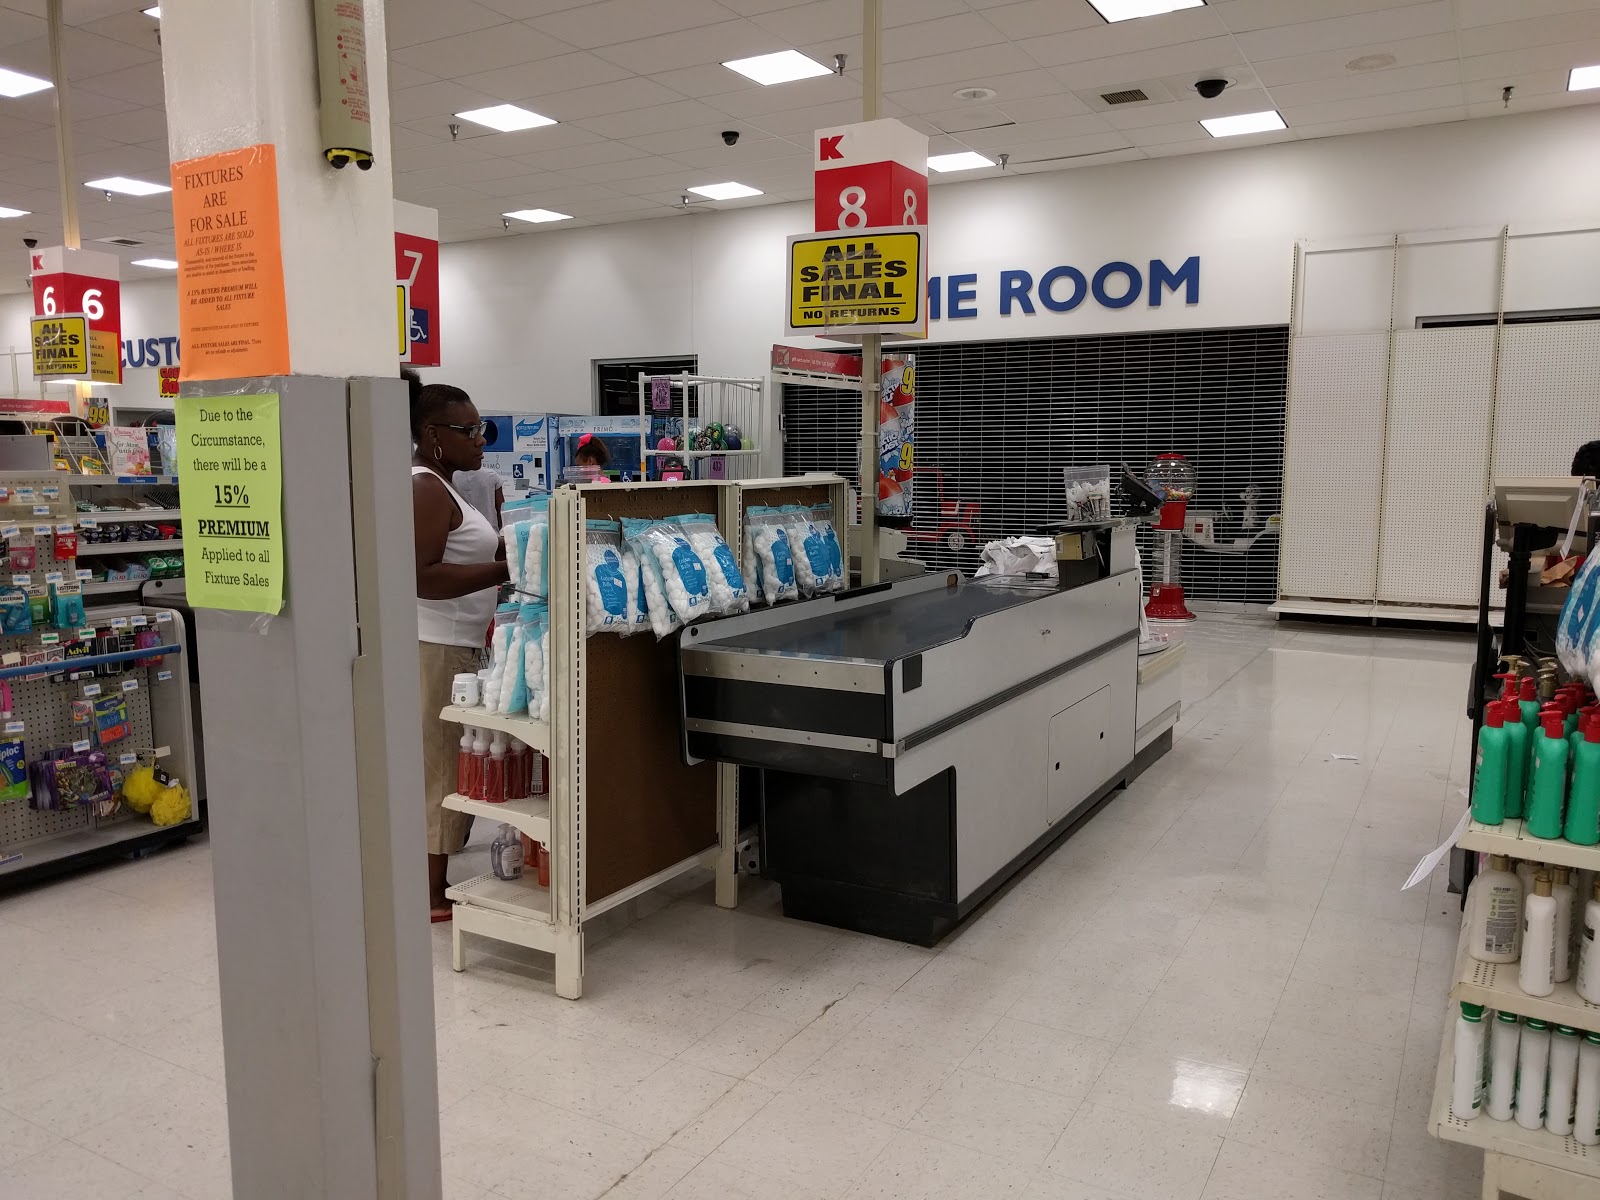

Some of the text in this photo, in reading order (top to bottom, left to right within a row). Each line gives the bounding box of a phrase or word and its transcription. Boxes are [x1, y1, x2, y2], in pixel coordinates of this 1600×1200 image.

[819, 135, 844, 161] K
[184, 166, 243, 190] FIXTURES
[203, 191, 227, 208] ARE
[838, 186, 867, 230] 8
[903, 188, 918, 226] 8
[190, 210, 248, 233] FOR SALE
[184, 230, 254, 247] ALL FIXTURES ARE SOLD
[196, 247, 210, 256] AS-IS
[214, 244, 235, 253] WHERE
[822, 243, 881, 262] ALL
[32, 255, 43, 270] K
[404, 250, 423, 286] 7
[800, 260, 907, 282] SALES
[221, 284, 243, 293] PREMIUM
[803, 282, 902, 302] FINAL
[1000, 256, 1200, 315] ROOM
[43, 287, 56, 316] 6
[82, 289, 104, 320] 6
[198, 296, 215, 304] ADDED
[804, 307, 900, 319] NO RETURNS
[42, 323, 66, 334] ALL
[34, 334, 79, 347] SALES
[36, 348, 78, 359] FINAL
[122, 337, 180, 367] UST
[200, 408, 253, 422] Due to the
[191, 434, 265, 448] Circumstance,
[193, 458, 266, 470] there will be a
[215, 485, 249, 504] 15%
[198, 519, 270, 536] PREMIUM
[202, 547, 270, 564] Applied to all
[205, 571, 269, 587] Fixture Sales
[68, 646, 89, 656] Advil
[0, 746, 19, 761] ploc
